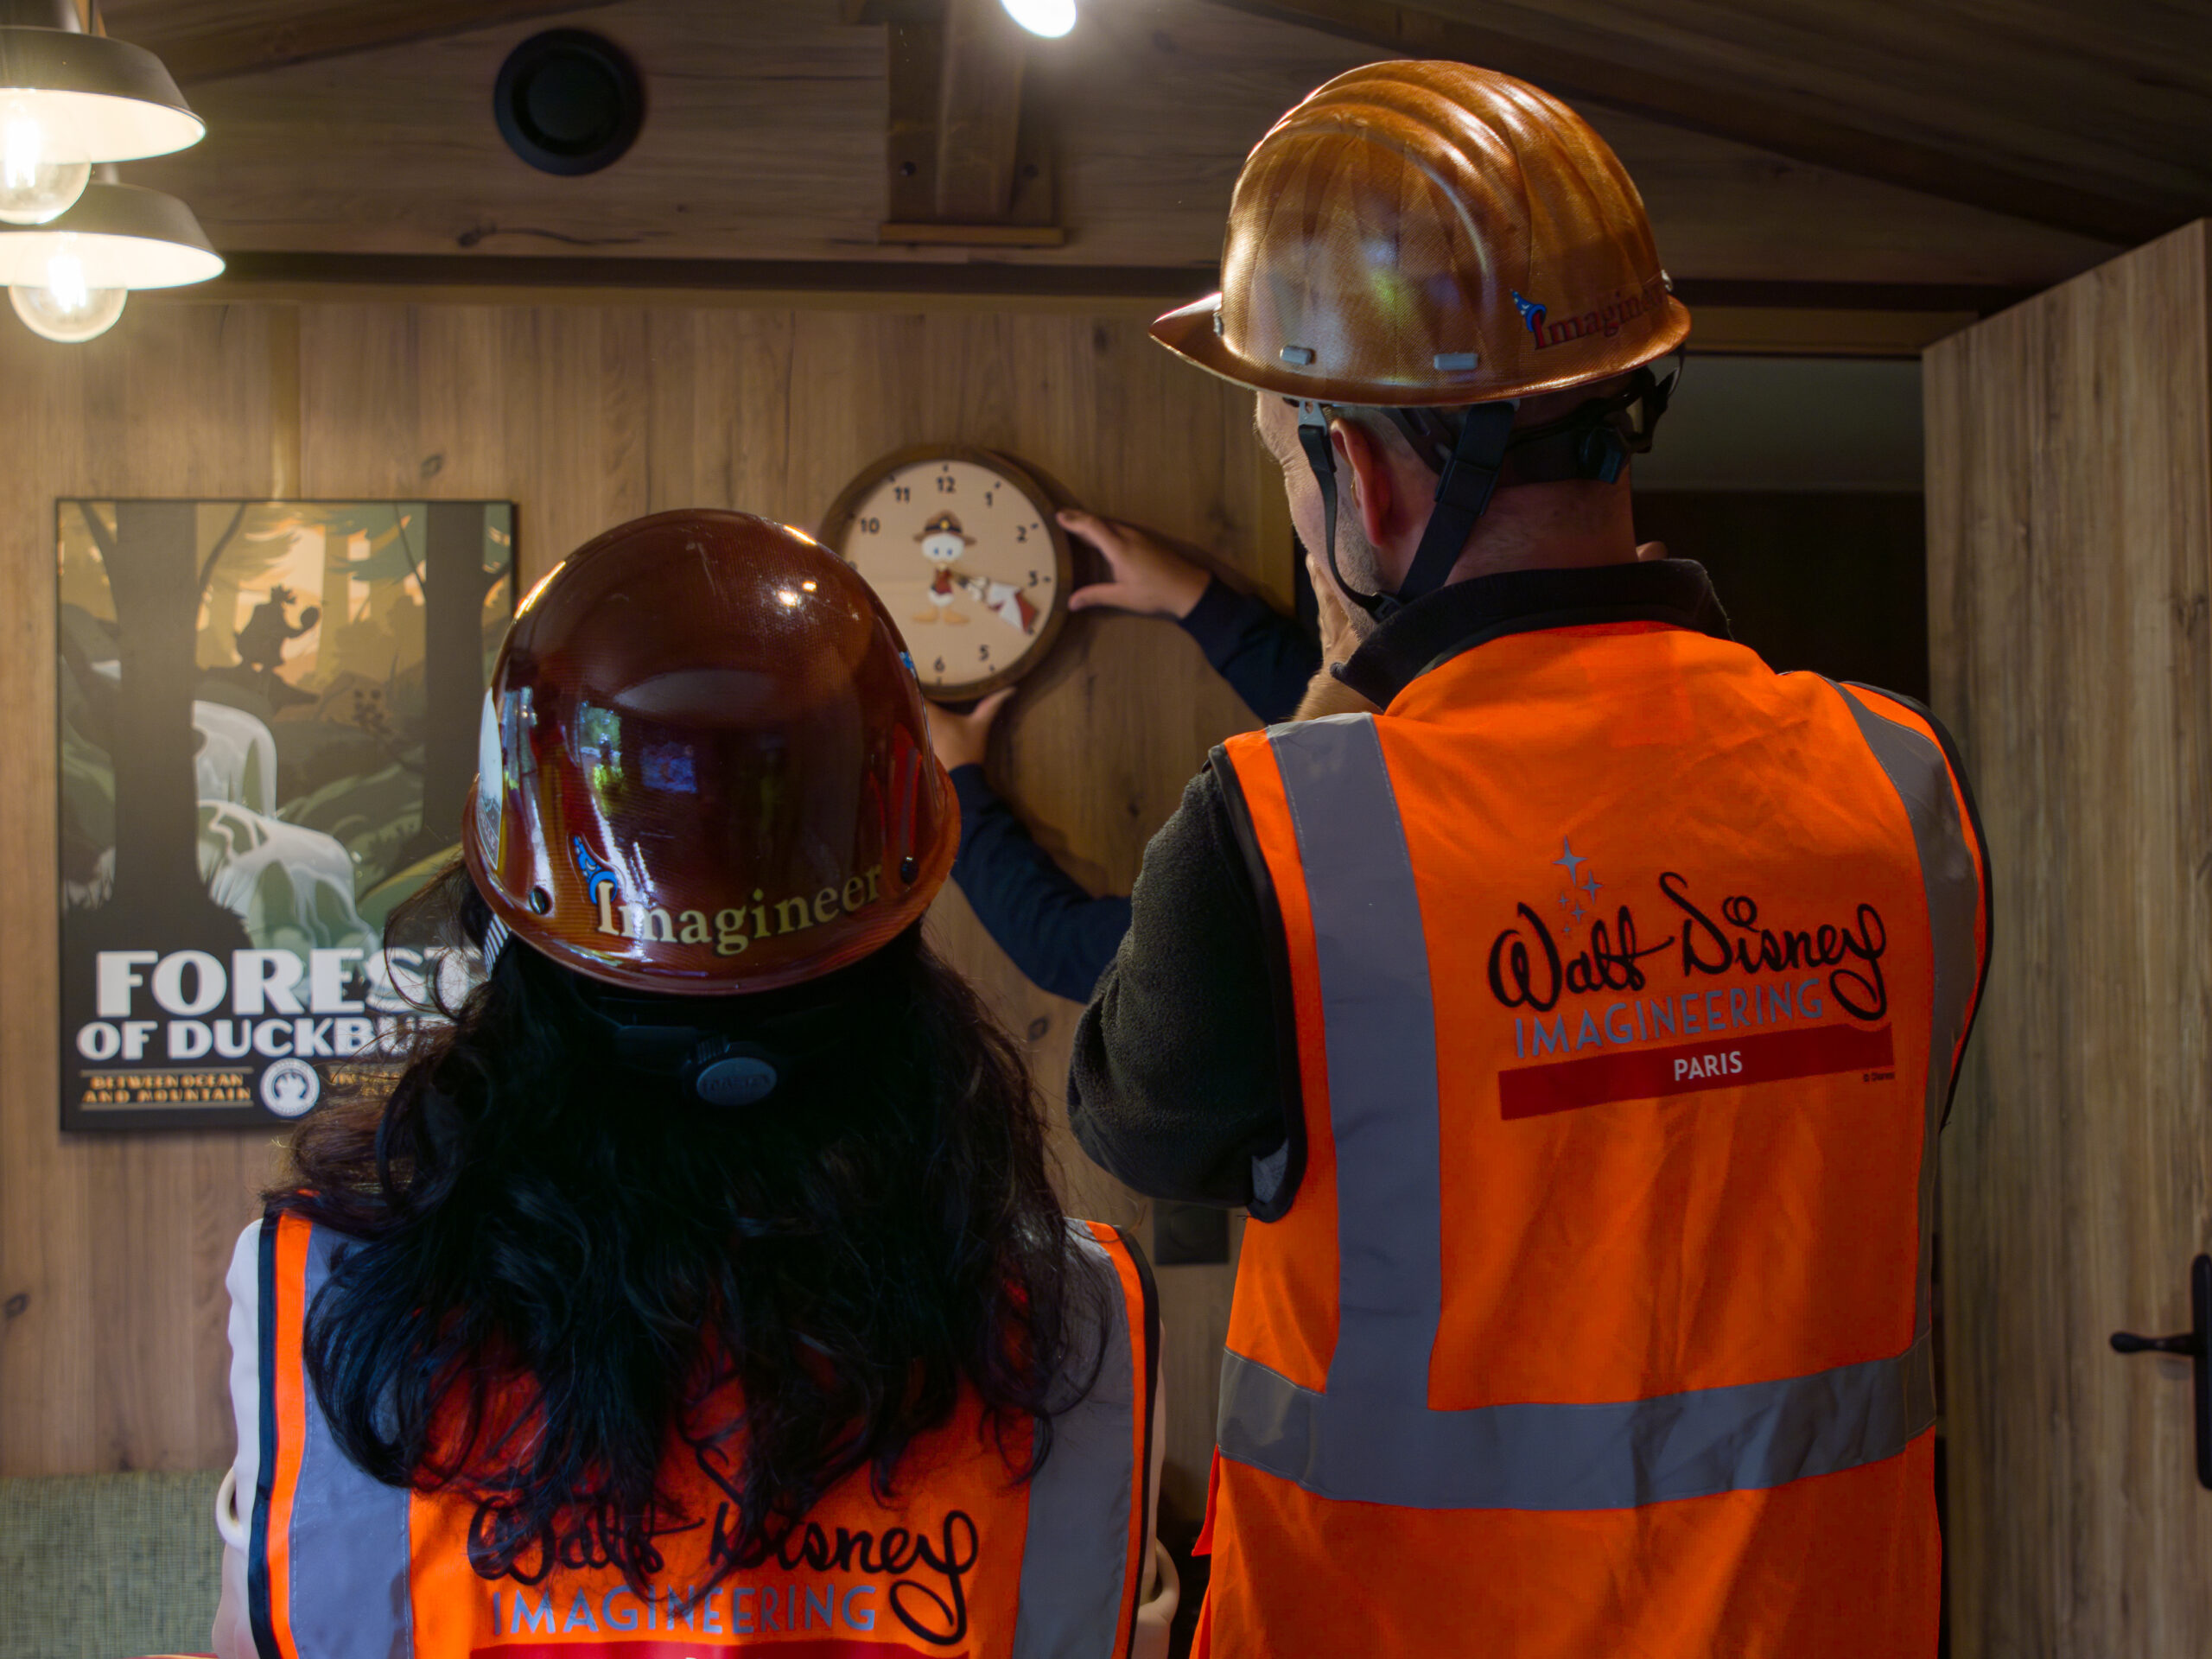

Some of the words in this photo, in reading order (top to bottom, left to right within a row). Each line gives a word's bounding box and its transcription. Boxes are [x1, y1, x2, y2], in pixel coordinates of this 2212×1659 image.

[938, 476, 955, 493] 12
[894, 486, 910, 502] 11
[985, 491, 992, 506] 1
[861, 518, 880, 533] 10
[1017, 525, 1027, 543] 2
[1029, 571, 1038, 587] 3
[980, 645, 989, 660] 5
[934, 657, 944, 672] 6
[598, 865, 882, 956] Imagineer
[1488, 902, 1675, 1013] Walt
[1659, 872, 1887, 1021] Disney
[1515, 978, 1823, 1059] IMAGINEERING
[76, 1020, 158, 1060] OF
[167, 1016, 459, 1059] DUCKBU
[1674, 1051, 1743, 1082] PARIS
[90, 1074, 179, 1090] BETWEEN
[181, 1072, 244, 1088] OCEAN
[82, 1089, 130, 1103] AND
[137, 1087, 251, 1103] MOUNTAIN
[493, 1584, 876, 1636] IMAGINEERING
